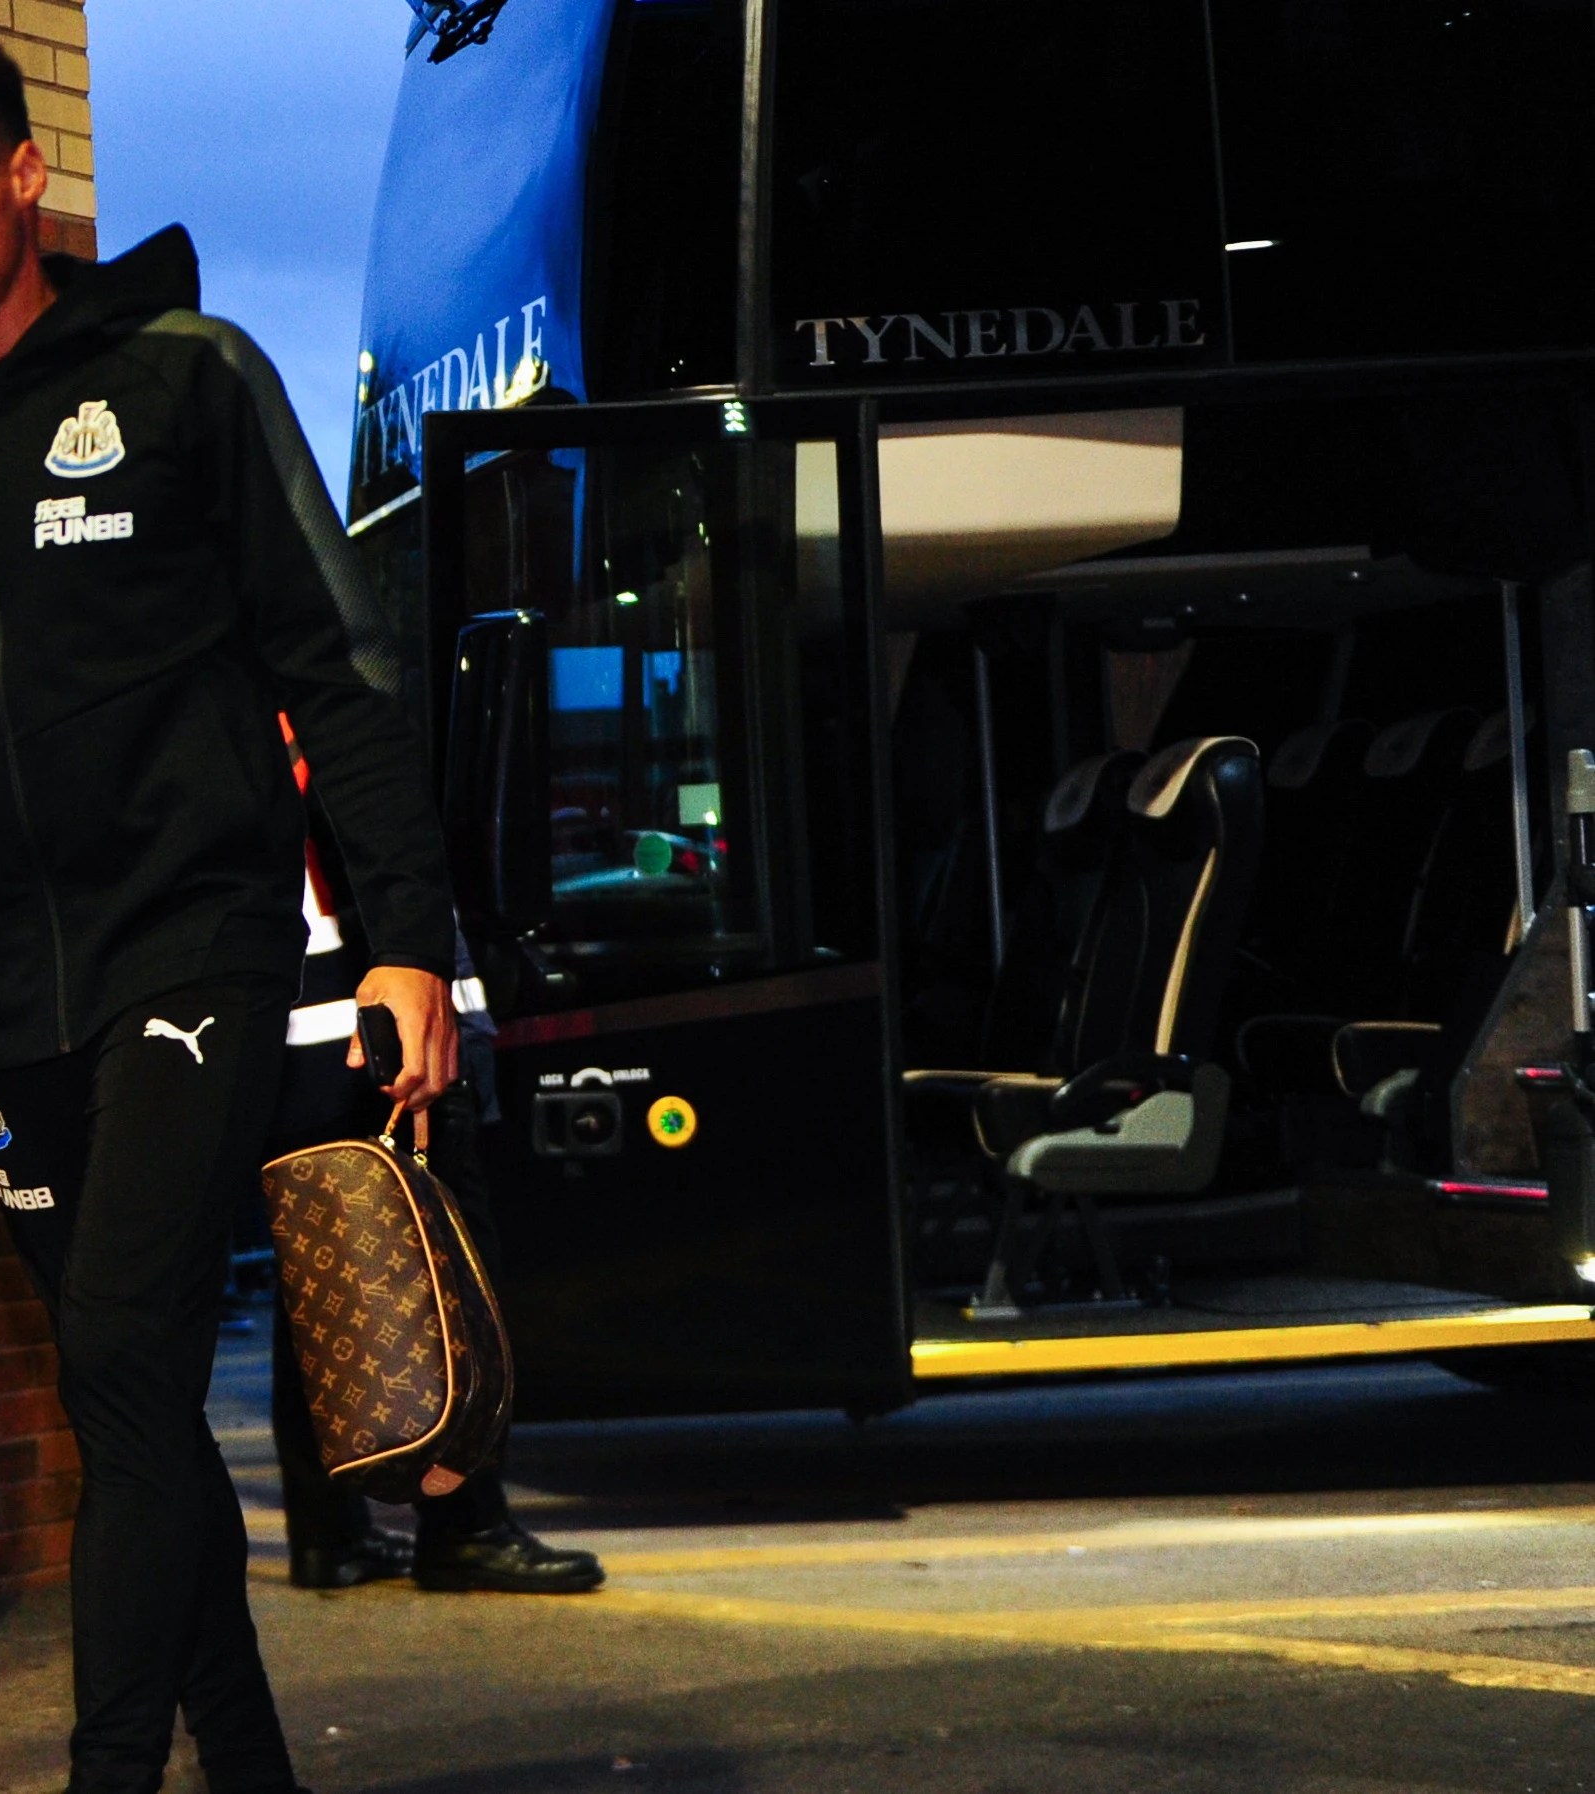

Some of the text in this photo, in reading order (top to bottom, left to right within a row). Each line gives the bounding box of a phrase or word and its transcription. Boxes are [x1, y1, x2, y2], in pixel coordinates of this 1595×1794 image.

[795, 299, 1205, 366] TYNEDALE
[359, 295, 548, 486] TYNEDALE
[35, 511, 133, 549] FUN88
[539, 1067, 650, 1086] LOCK UNLOCK
